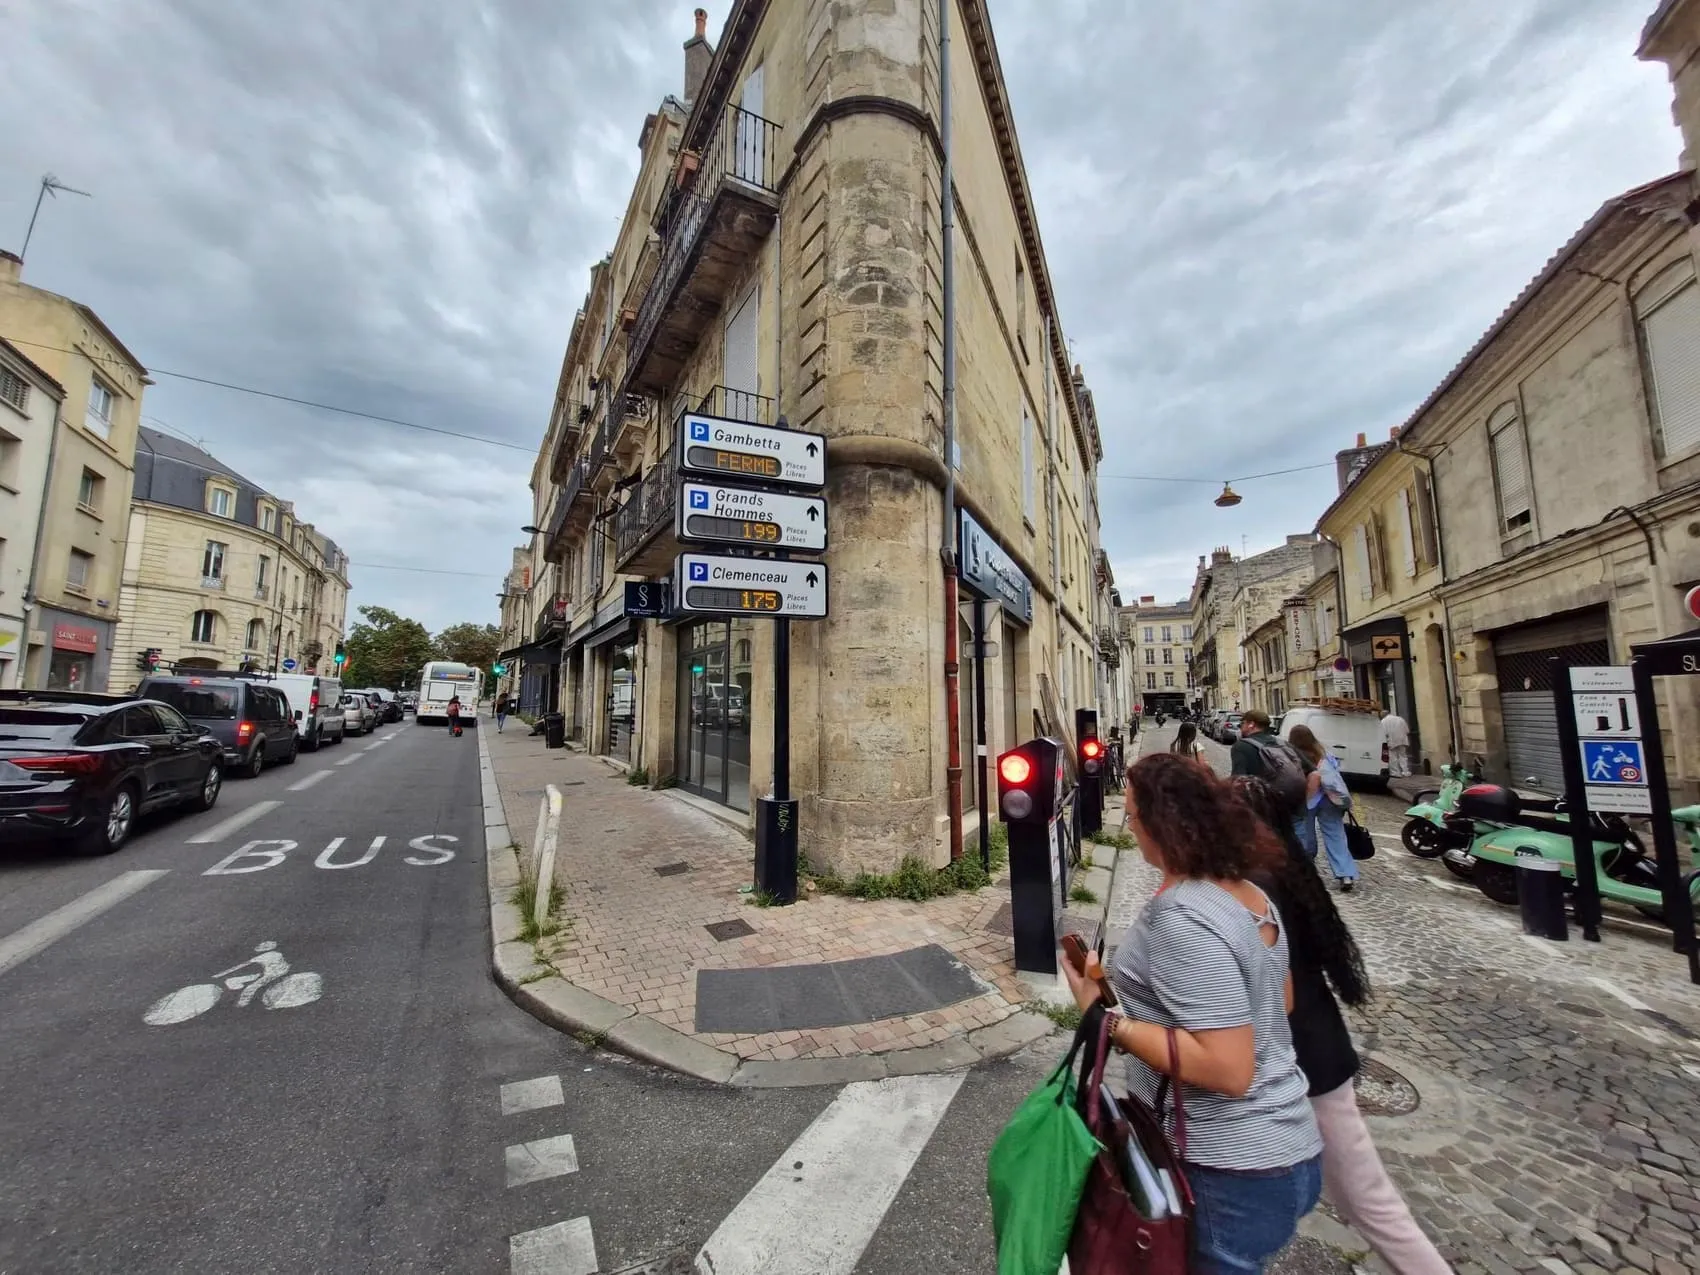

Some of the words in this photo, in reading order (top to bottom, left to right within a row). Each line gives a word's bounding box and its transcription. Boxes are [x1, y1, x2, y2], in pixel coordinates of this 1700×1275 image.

[714, 429, 781, 451] Gambetta
[716, 452, 777, 475] FERME
[785, 461, 807, 471] Places
[785, 470, 806, 479] Libres
[715, 489, 764, 506] Grands
[714, 503, 773, 521] Hommes
[743, 522, 777, 539] 199
[786, 526, 808, 536] Places
[786, 535, 806, 543] Libres
[712, 567, 788, 584] Clemenceau
[742, 591, 777, 609] 175
[786, 593, 808, 602] Places
[786, 602, 806, 610] Libres
[201, 834, 460, 876] BUS
